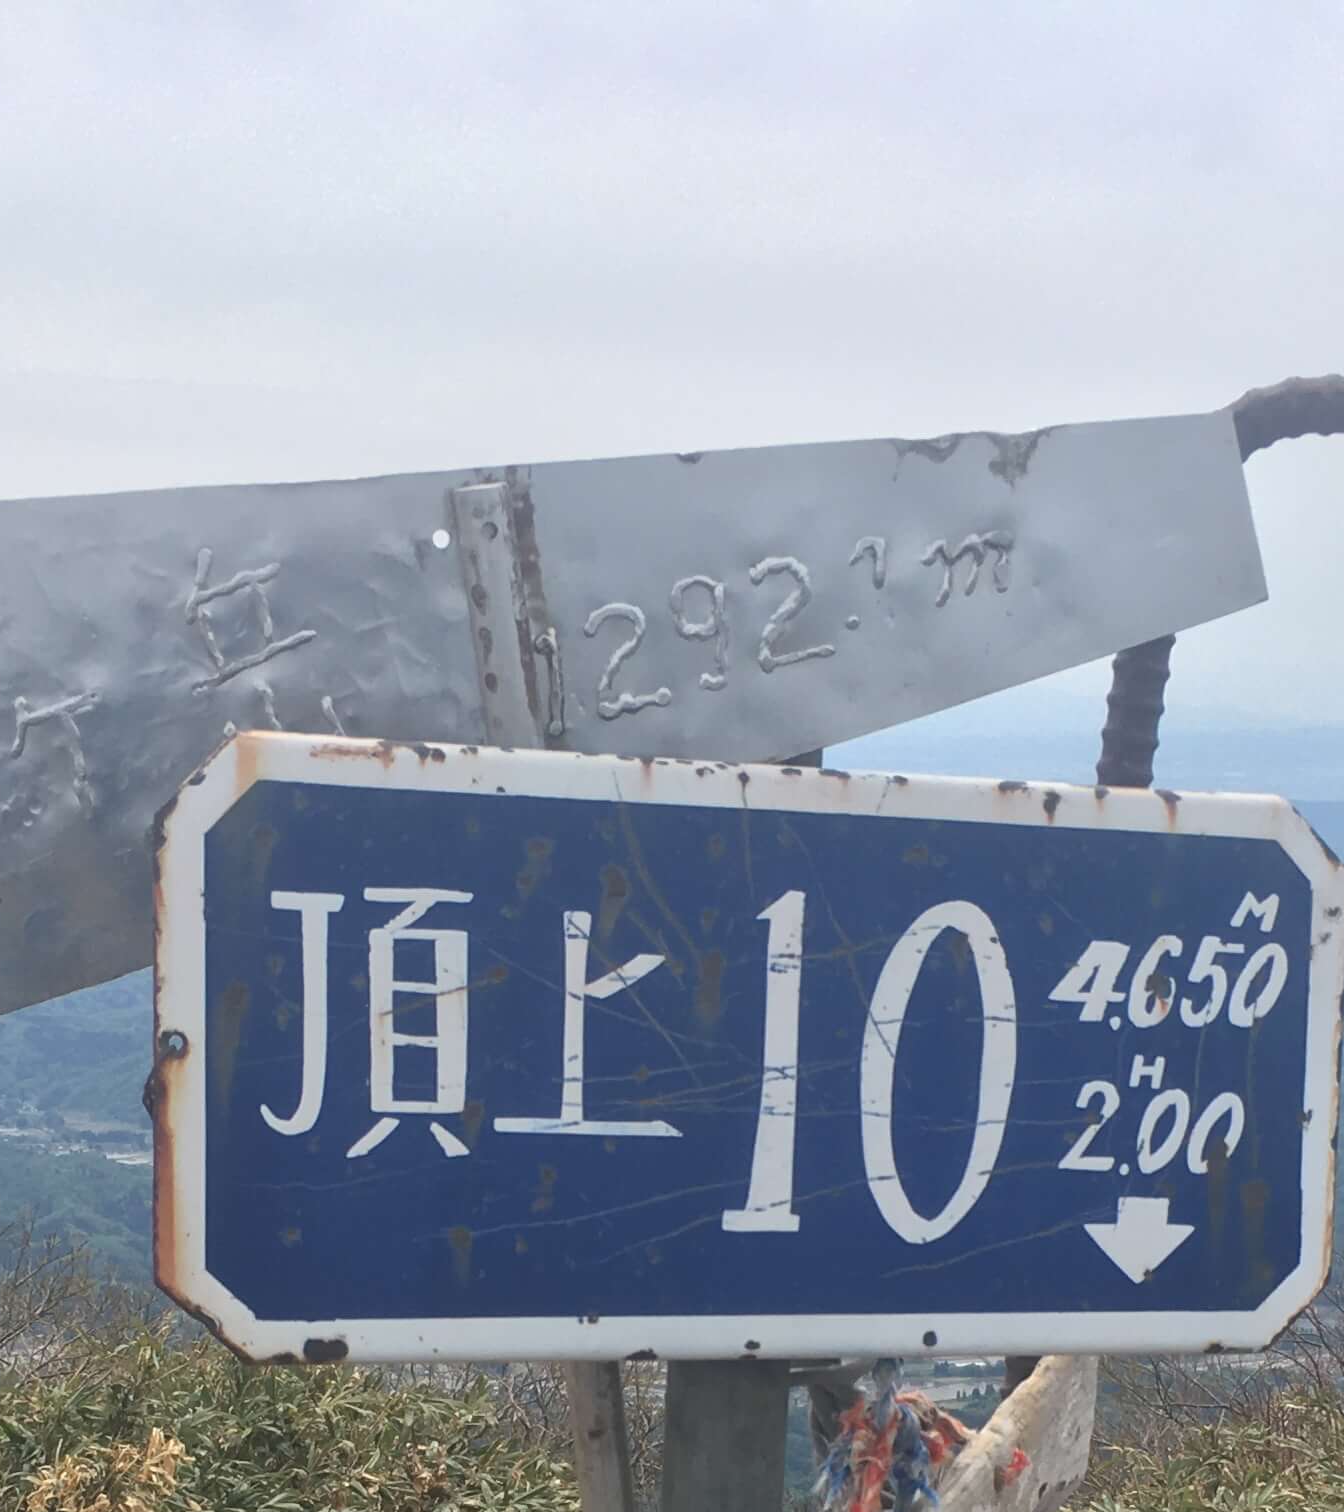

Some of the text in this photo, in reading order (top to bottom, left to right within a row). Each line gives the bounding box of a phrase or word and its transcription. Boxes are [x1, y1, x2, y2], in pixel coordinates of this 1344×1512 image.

[1229, 891, 1281, 933] M
[259, 886, 1017, 1245] 頂上 10
[1129, 1053, 1166, 1089] H
[1057, 1080, 1245, 1176] 2.00
